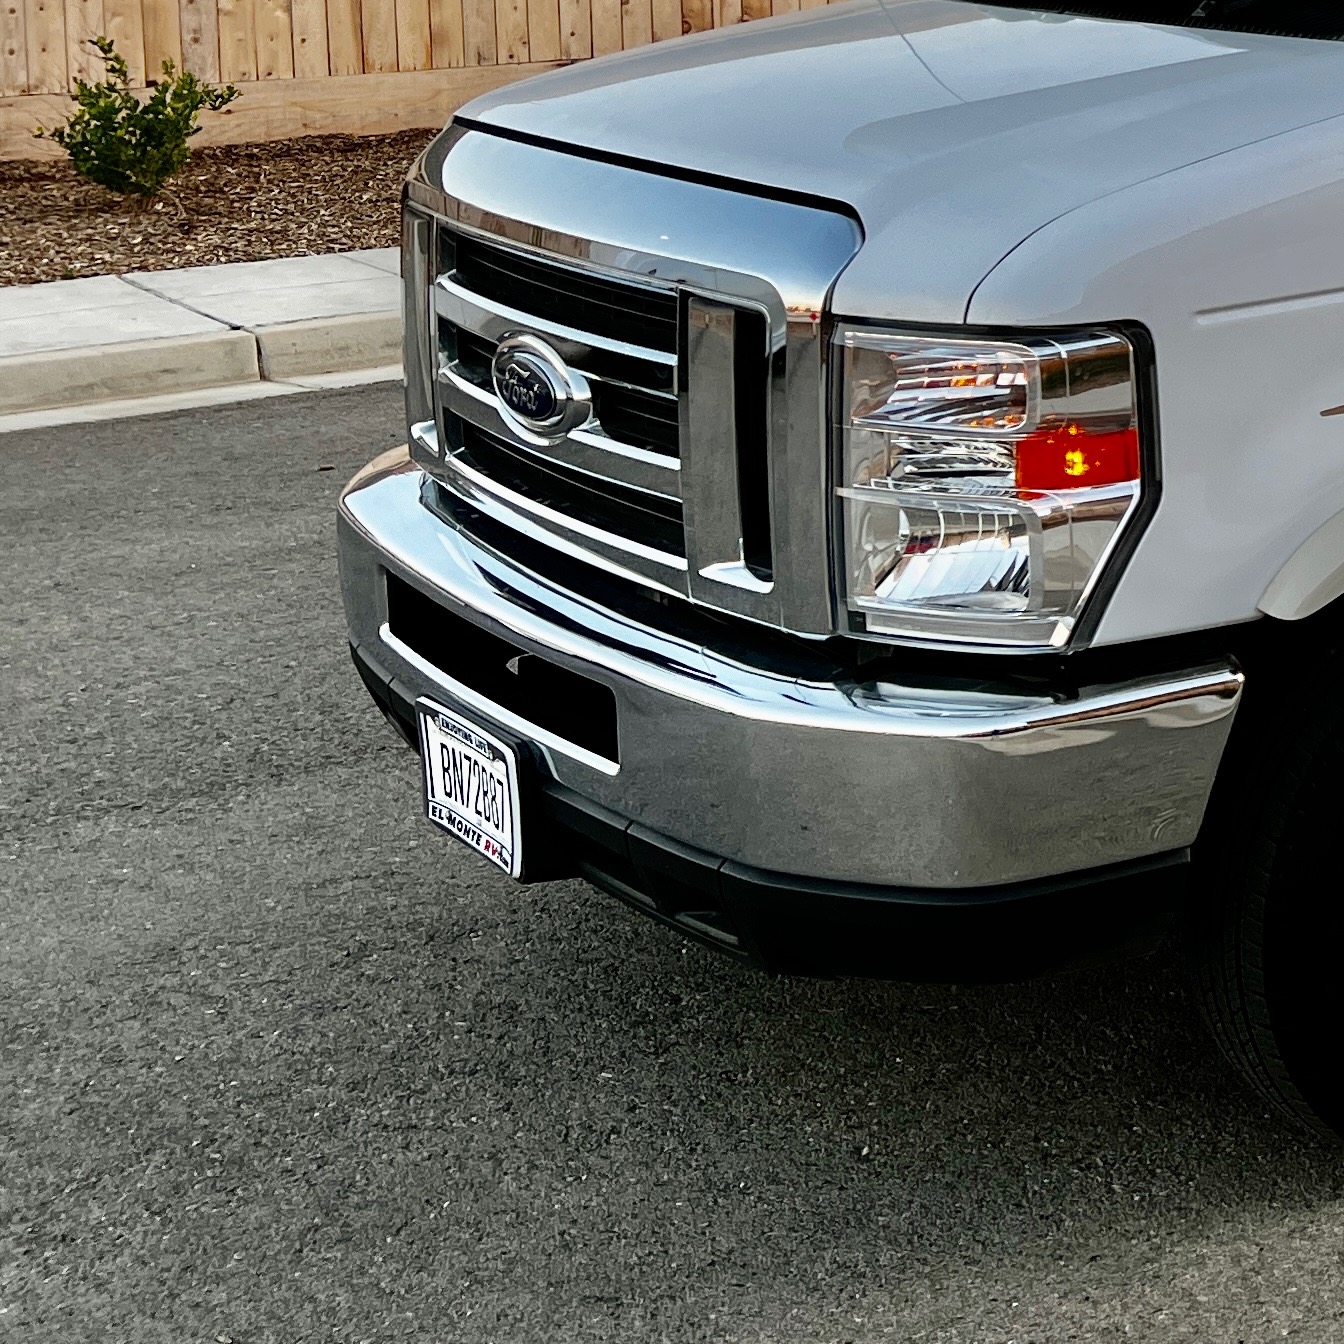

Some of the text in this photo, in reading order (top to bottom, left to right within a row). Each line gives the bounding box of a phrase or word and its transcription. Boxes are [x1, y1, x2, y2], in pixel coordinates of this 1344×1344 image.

[502, 363, 541, 412] Ford
[440, 742, 505, 834] BN72B87
[431, 804, 444, 821] EL
[447, 810, 483, 847] MONTE
